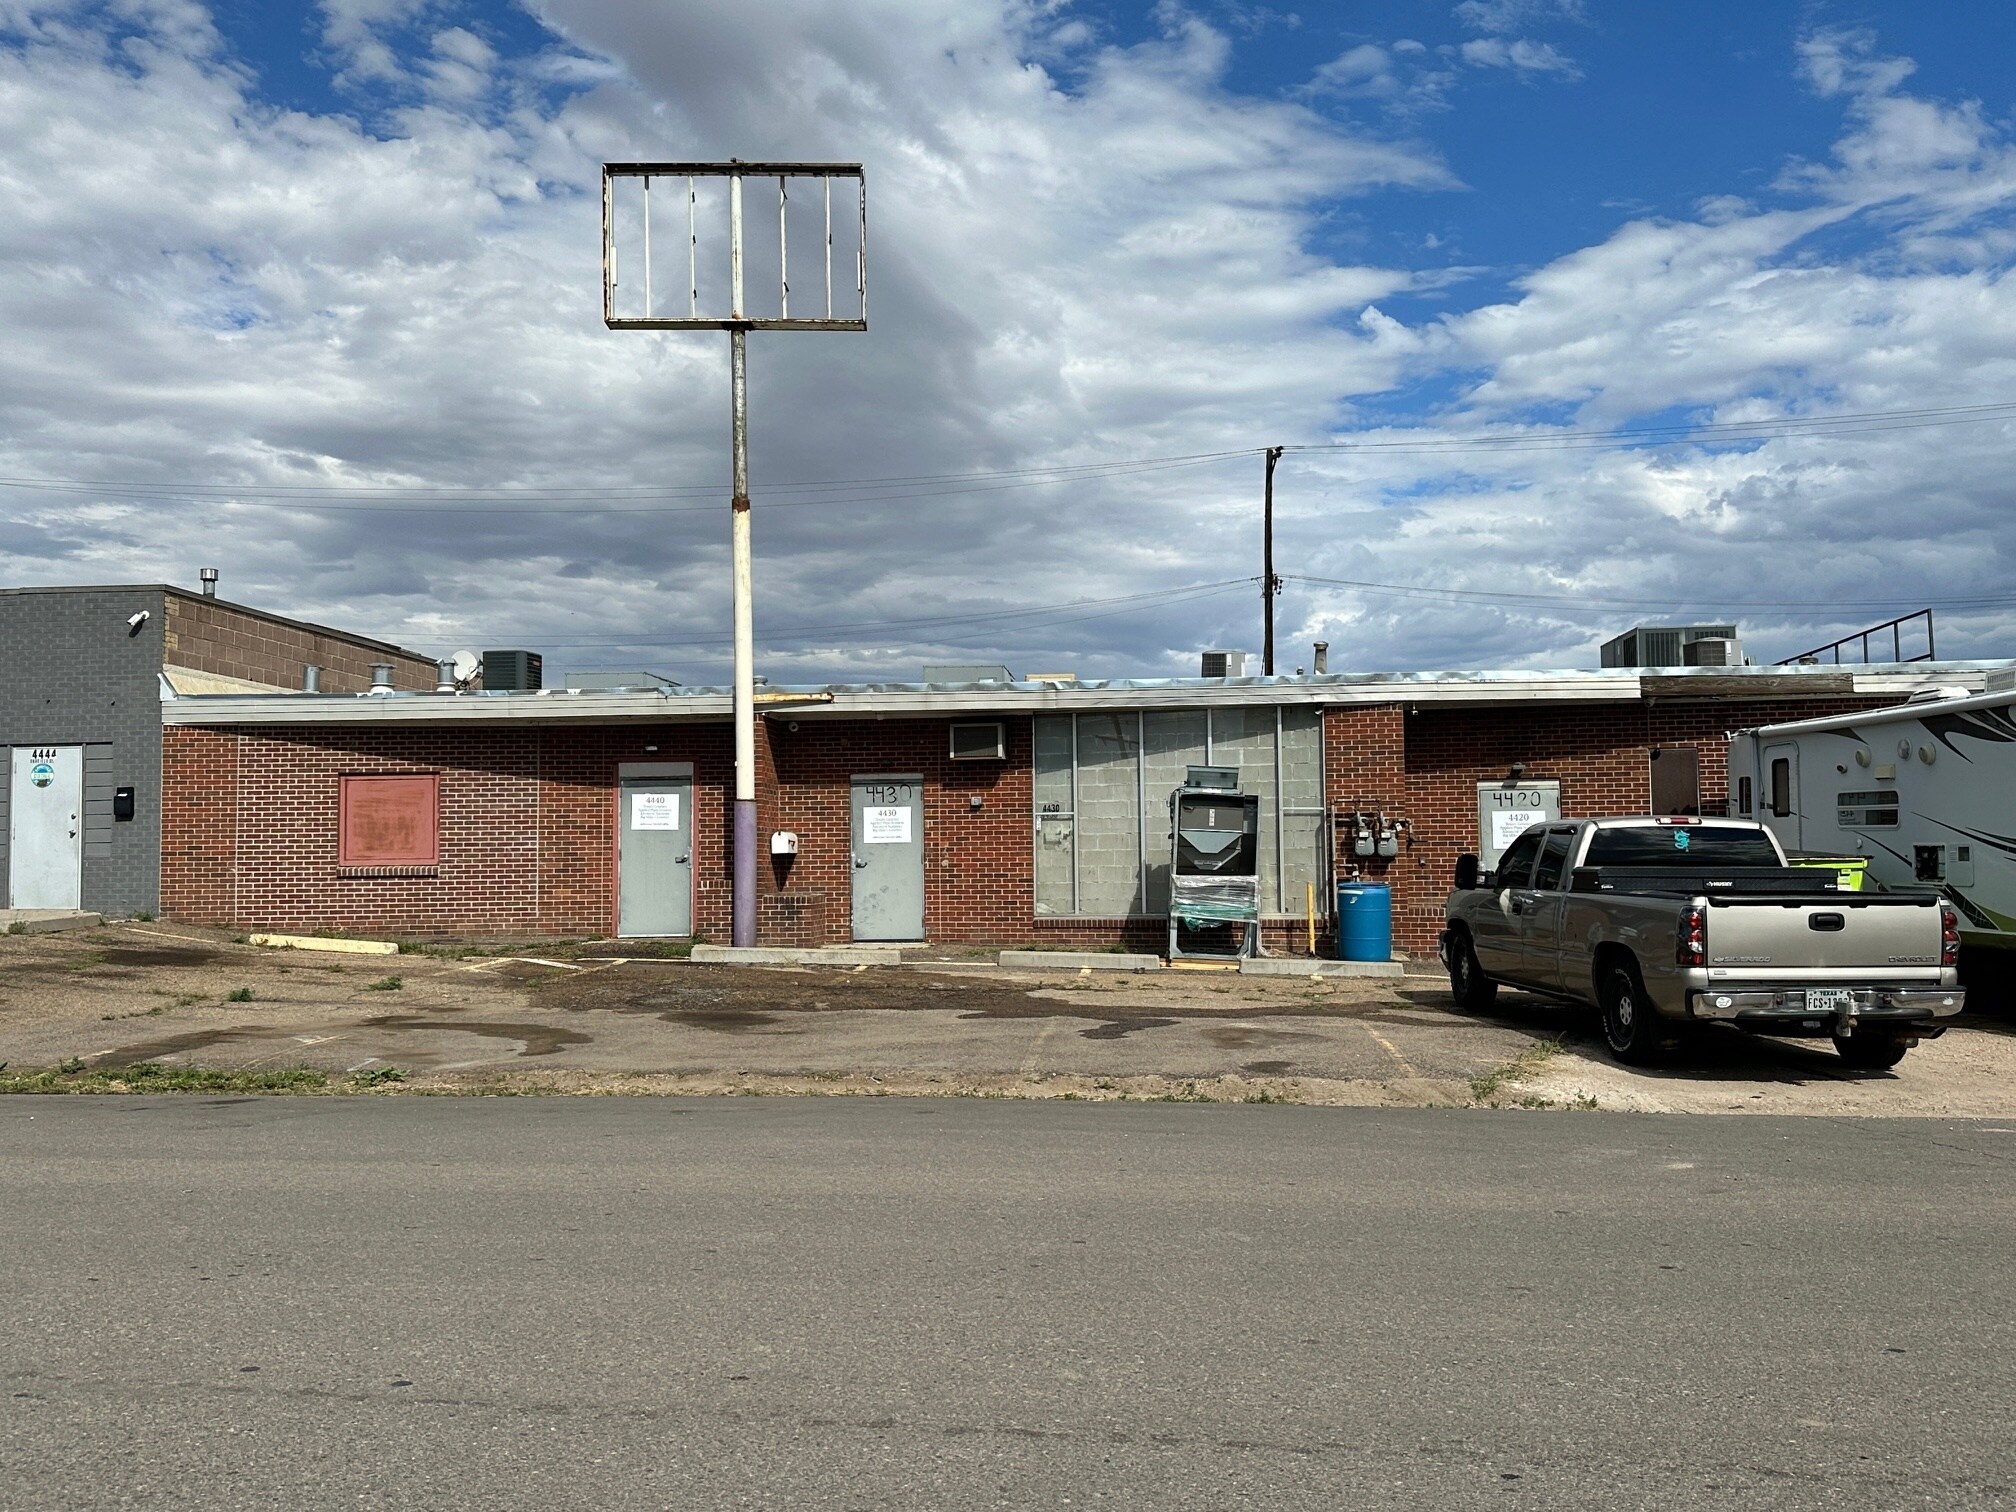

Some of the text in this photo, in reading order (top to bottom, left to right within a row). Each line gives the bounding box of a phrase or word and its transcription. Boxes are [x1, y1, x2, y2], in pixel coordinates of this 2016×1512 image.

[32, 749, 57, 759] 4444
[866, 783, 912, 804] 4430
[646, 796, 665, 804] 4440
[1493, 791, 1541, 807] 4420
[1042, 803, 1060, 813] 4430
[878, 809, 897, 817] 4430
[1508, 813, 1530, 822] 4420
[1887, 955, 1937, 963] CHEVROLET
